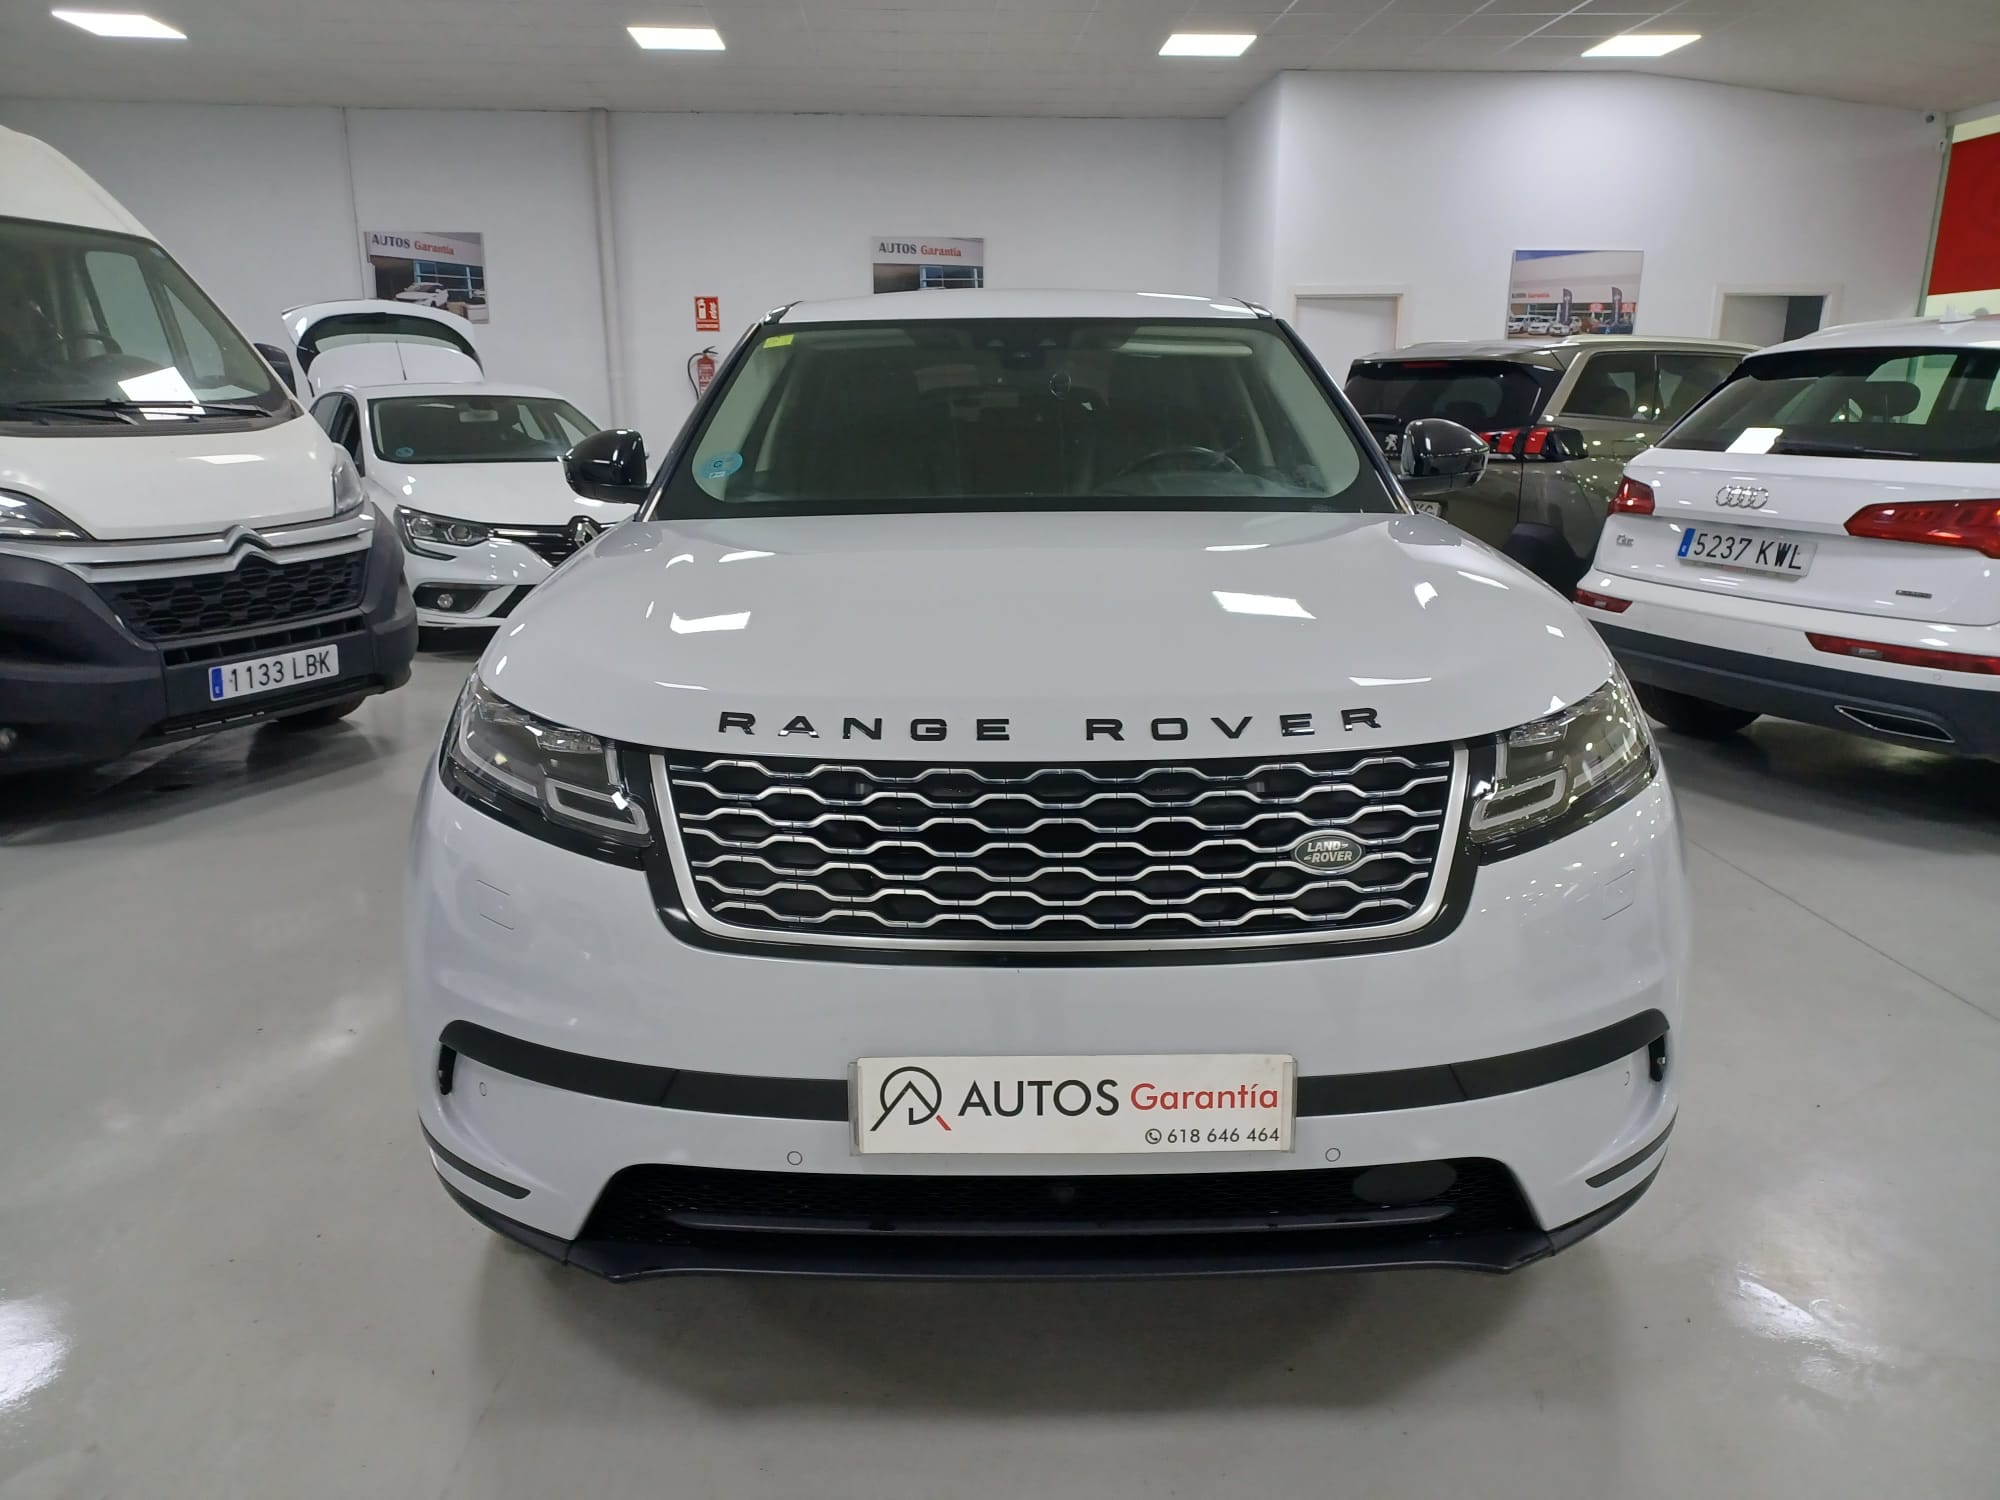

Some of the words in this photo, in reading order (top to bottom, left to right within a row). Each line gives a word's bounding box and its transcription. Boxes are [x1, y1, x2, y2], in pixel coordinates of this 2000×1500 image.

[372, 234, 410, 249] AUTOS
[879, 242, 917, 255] AUTOS
[1694, 533, 1753, 561] 5237
[1755, 540, 1802, 570] KWL
[231, 660, 284, 692] 1133
[292, 650, 331, 680] LBK
[718, 711, 1010, 742] RANGE
[1086, 707, 1382, 741] ROVER
[1307, 840, 1341, 853] LAND
[1311, 850, 1353, 864] ROVER
[958, 1079, 1120, 1117] AUTOS
[1130, 1082, 1278, 1111] Garantía
[1167, 1128, 1200, 1144] 618
[1207, 1127, 1240, 1143] 646
[1246, 1127, 1279, 1142] 464
